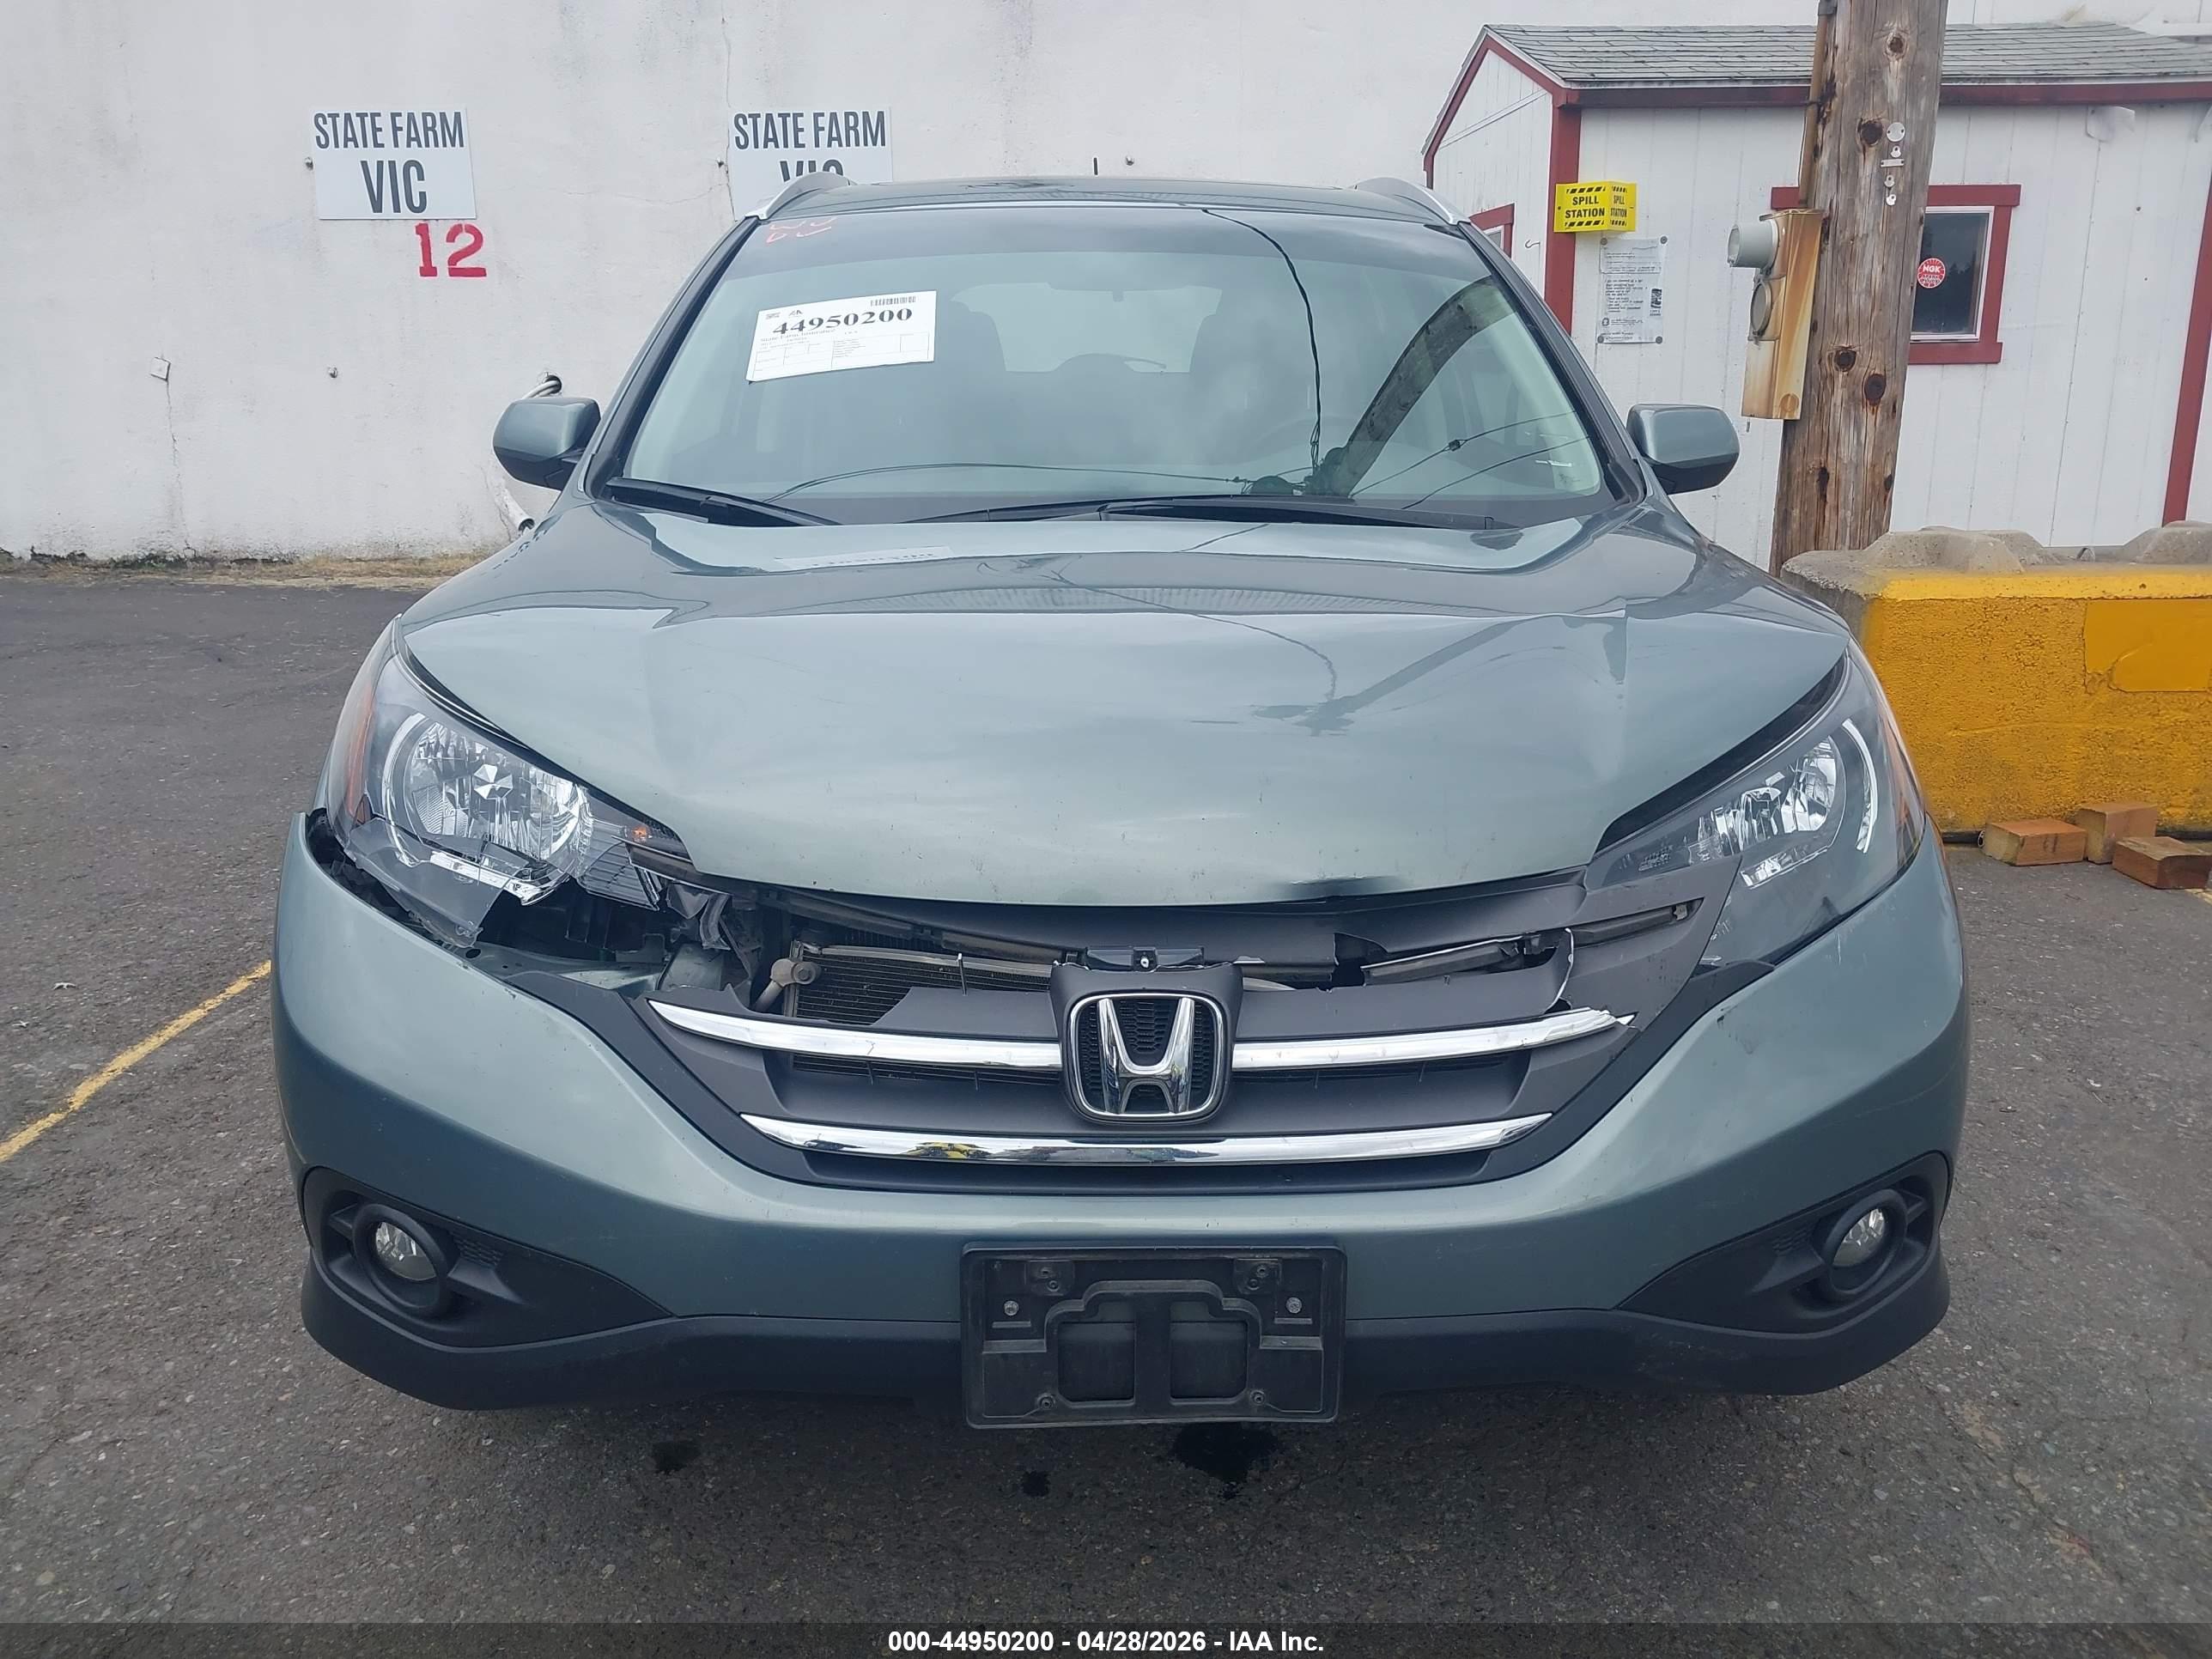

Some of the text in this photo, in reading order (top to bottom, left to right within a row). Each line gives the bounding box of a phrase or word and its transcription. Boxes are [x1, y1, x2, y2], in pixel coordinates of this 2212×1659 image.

[313, 112, 465, 149] STATE FARM
[733, 111, 886, 150] STATE FARM
[360, 160, 428, 214] VIC
[1572, 195, 1599, 206] SPILL
[1613, 194, 1626, 205] SPILL
[1565, 207, 1605, 219] STATION
[1610, 207, 1627, 218] STATION
[415, 222, 487, 277] 12
[1923, 264, 1942, 274] NGK
[772, 307, 913, 335] 44950200
